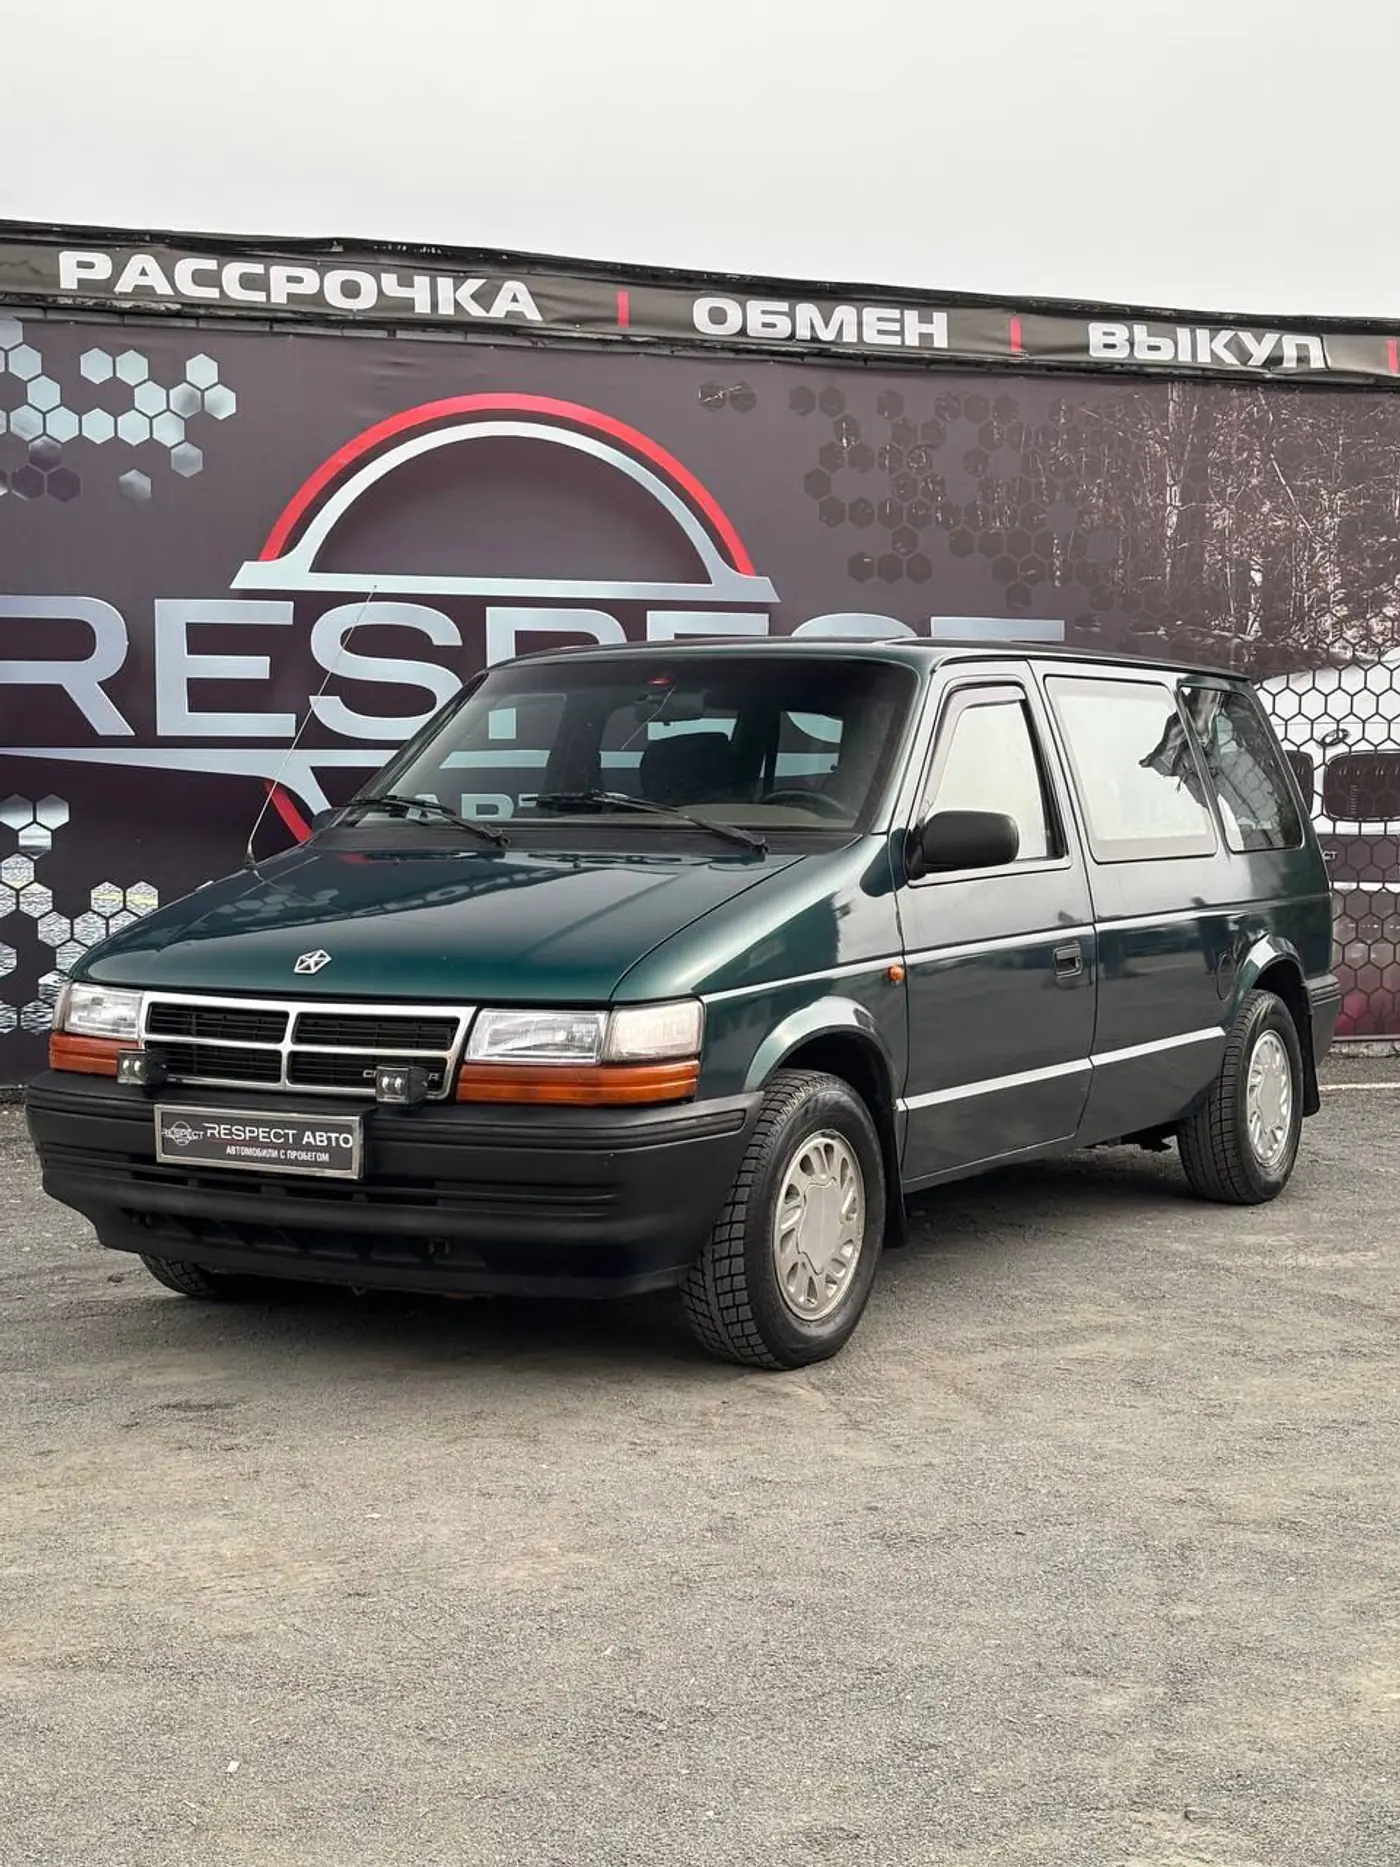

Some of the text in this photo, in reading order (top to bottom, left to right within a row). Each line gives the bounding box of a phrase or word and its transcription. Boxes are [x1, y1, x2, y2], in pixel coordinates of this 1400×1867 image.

[57, 249, 1329, 369] РАССРОЧКА ОБМЕН ВЫКУП
[203, 1122, 353, 1148] RESPECT АВТО
[226, 1144, 330, 1162] АВТОМОБИЛИ С ПРОБЕГОМ
